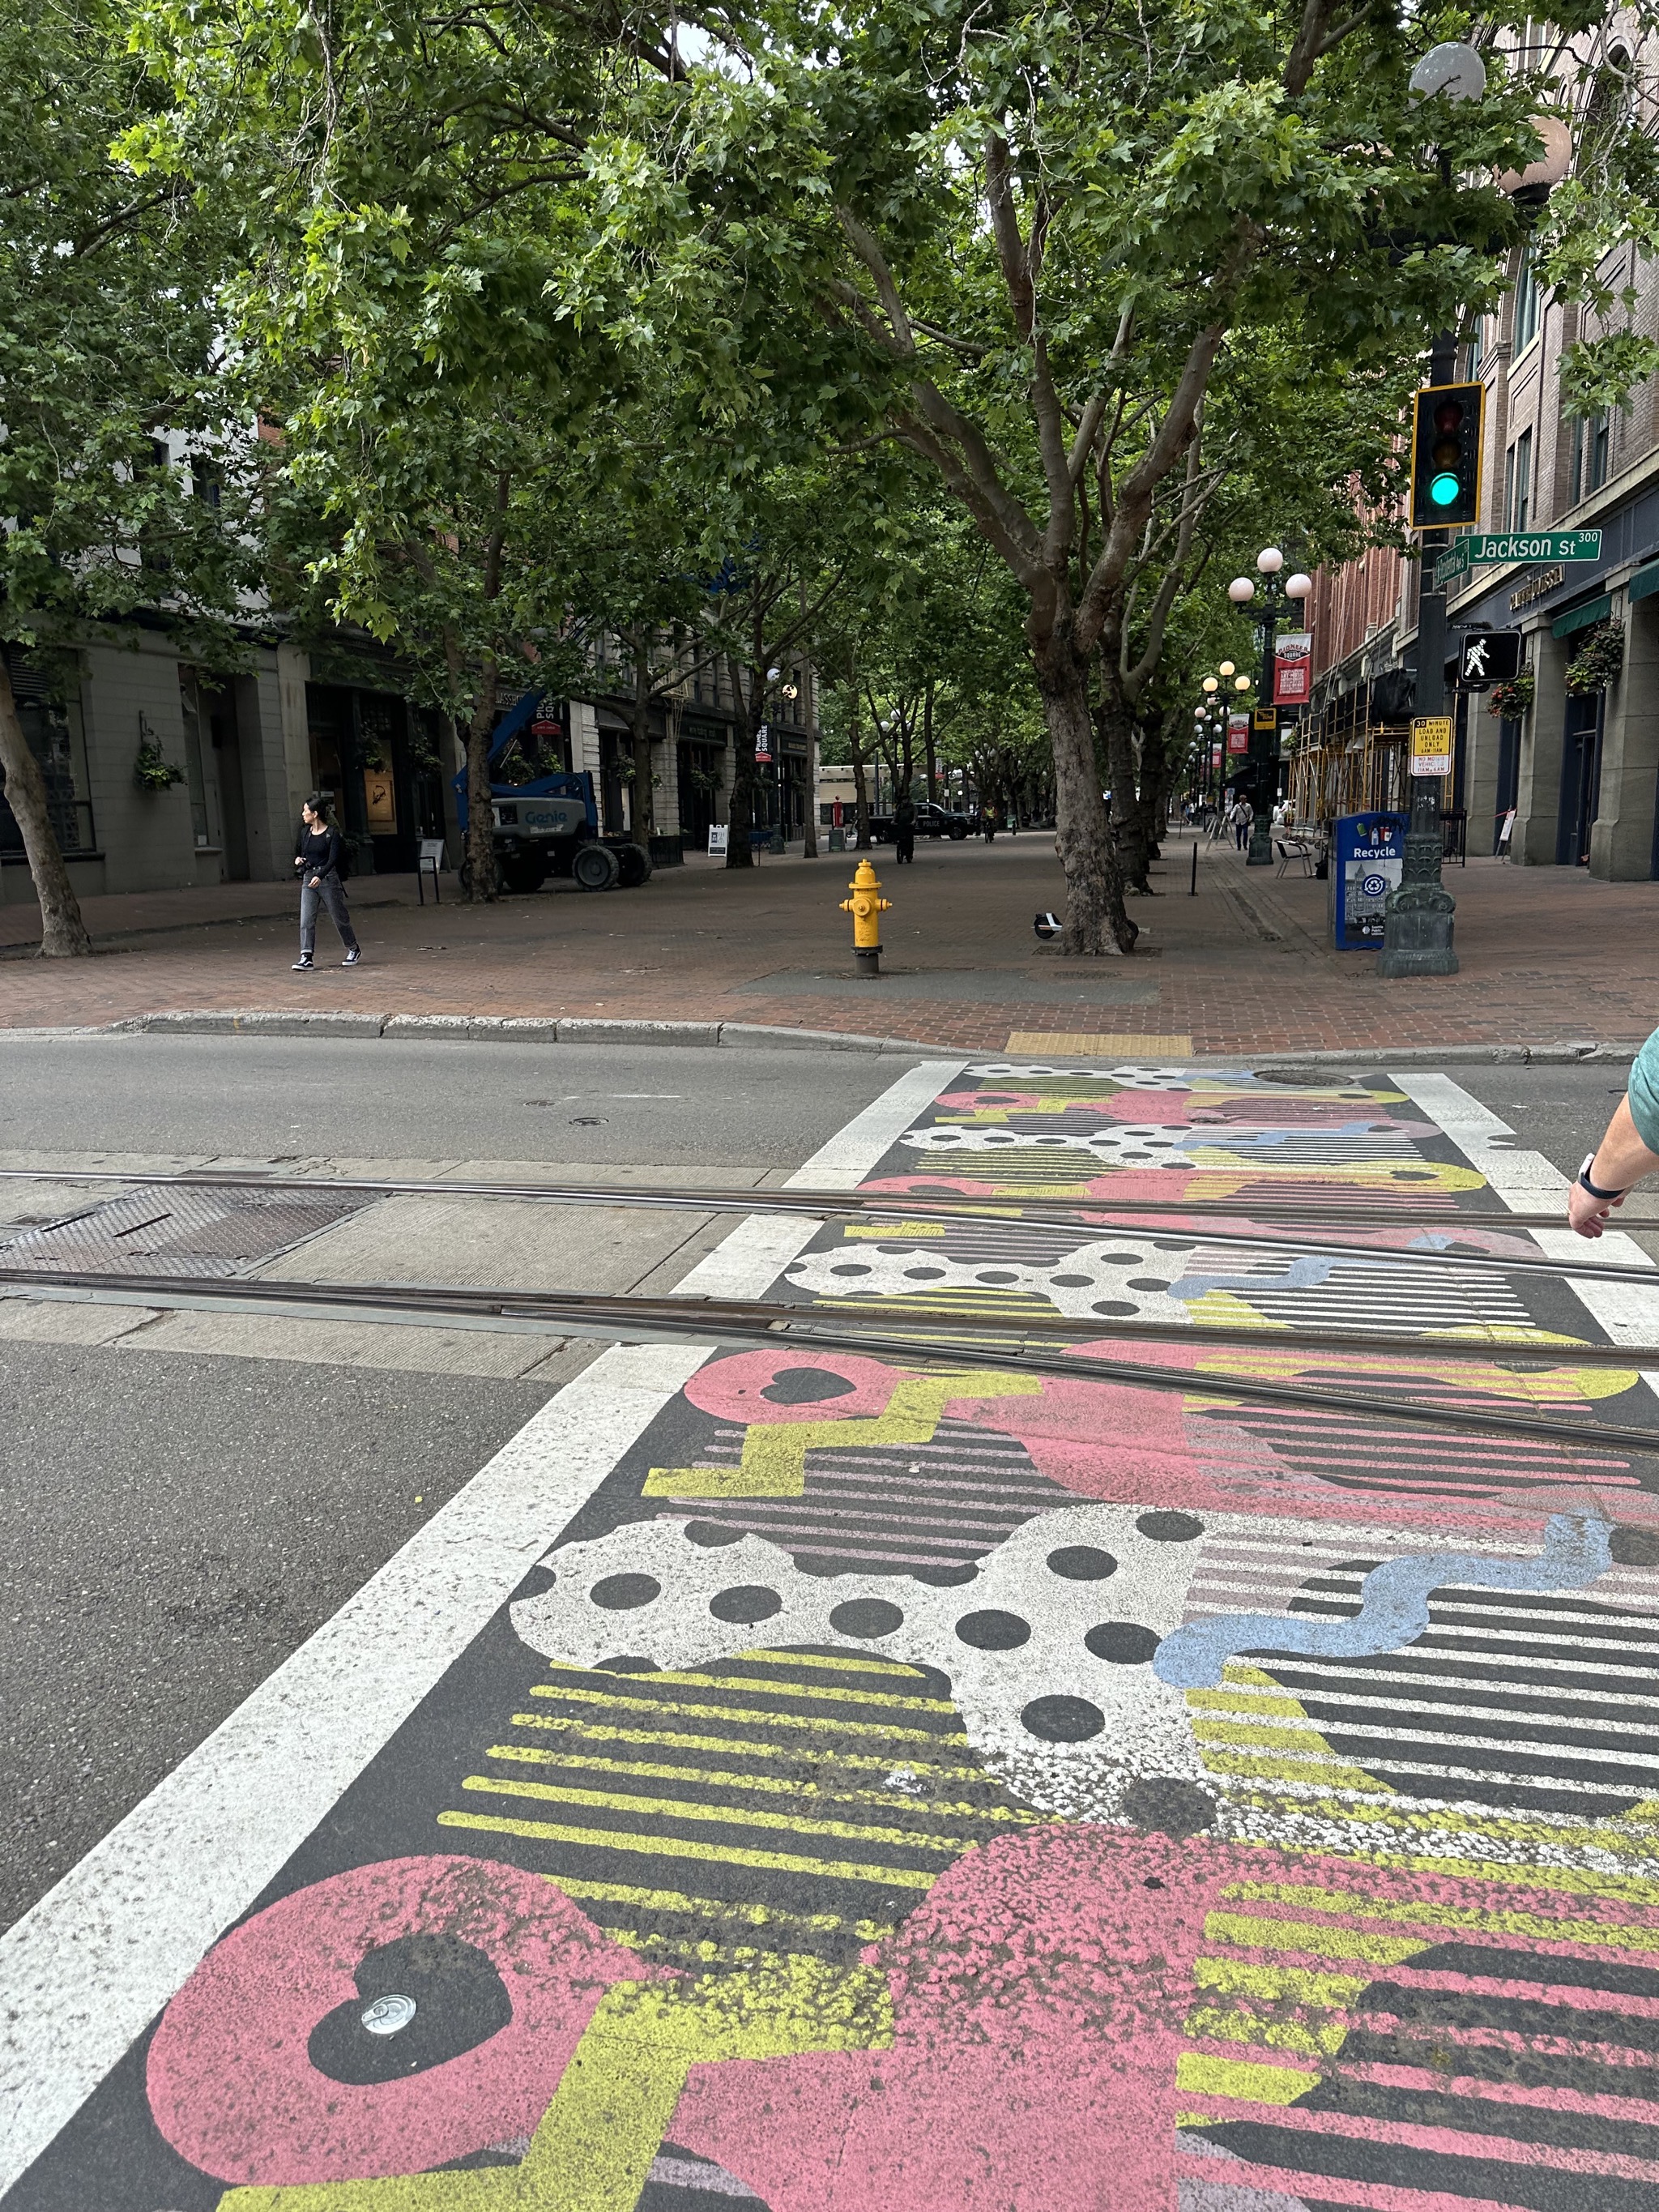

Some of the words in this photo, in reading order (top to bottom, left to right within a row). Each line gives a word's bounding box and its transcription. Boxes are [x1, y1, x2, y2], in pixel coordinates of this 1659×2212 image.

[1474, 536, 1551, 558] Jackson
[1559, 540, 1576, 555] St
[1579, 532, 1597, 542] 300
[1277, 643, 1309, 655] PIONEER
[525, 810, 568, 824] Genie
[1354, 847, 1396, 859] Recycle
